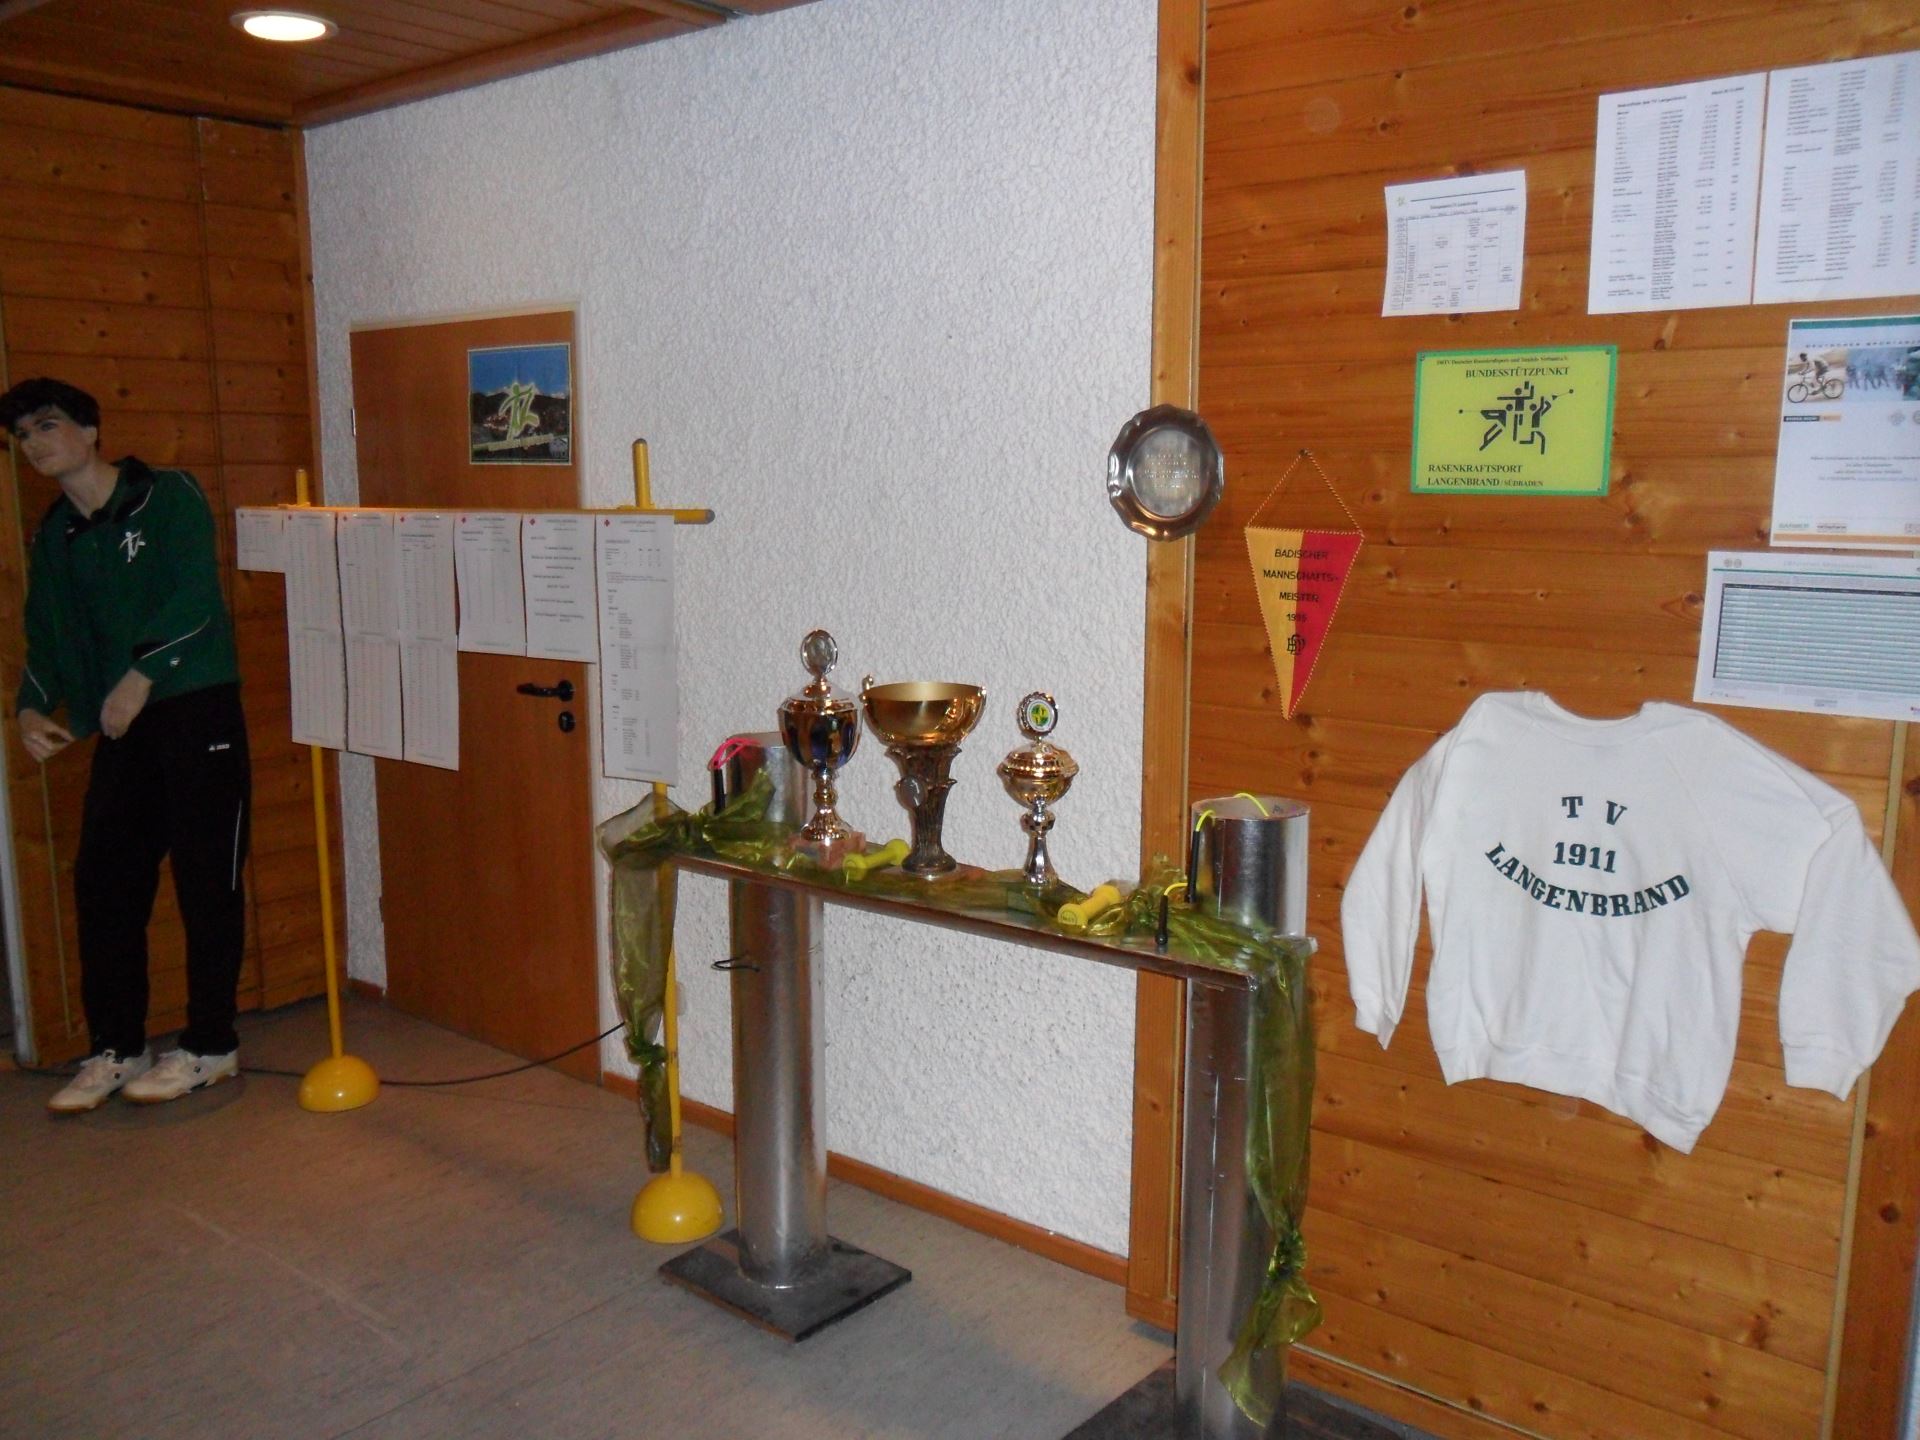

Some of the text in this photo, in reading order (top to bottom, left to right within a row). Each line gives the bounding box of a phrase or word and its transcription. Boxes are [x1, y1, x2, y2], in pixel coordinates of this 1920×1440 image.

[1466, 366, 1569, 378] BUNDESSTÜTZPUNKT
[1428, 464, 1523, 473] RASENKRAFTSPORT
[1427, 477, 1500, 487] LANGENBRAND
[1274, 548, 1328, 560] BADISCHER
[1279, 592, 1319, 602] MEISTER
[1561, 795, 1628, 826] T V
[1553, 841, 1617, 874] 1911
[1484, 841, 1691, 918] LANGENBRAND
